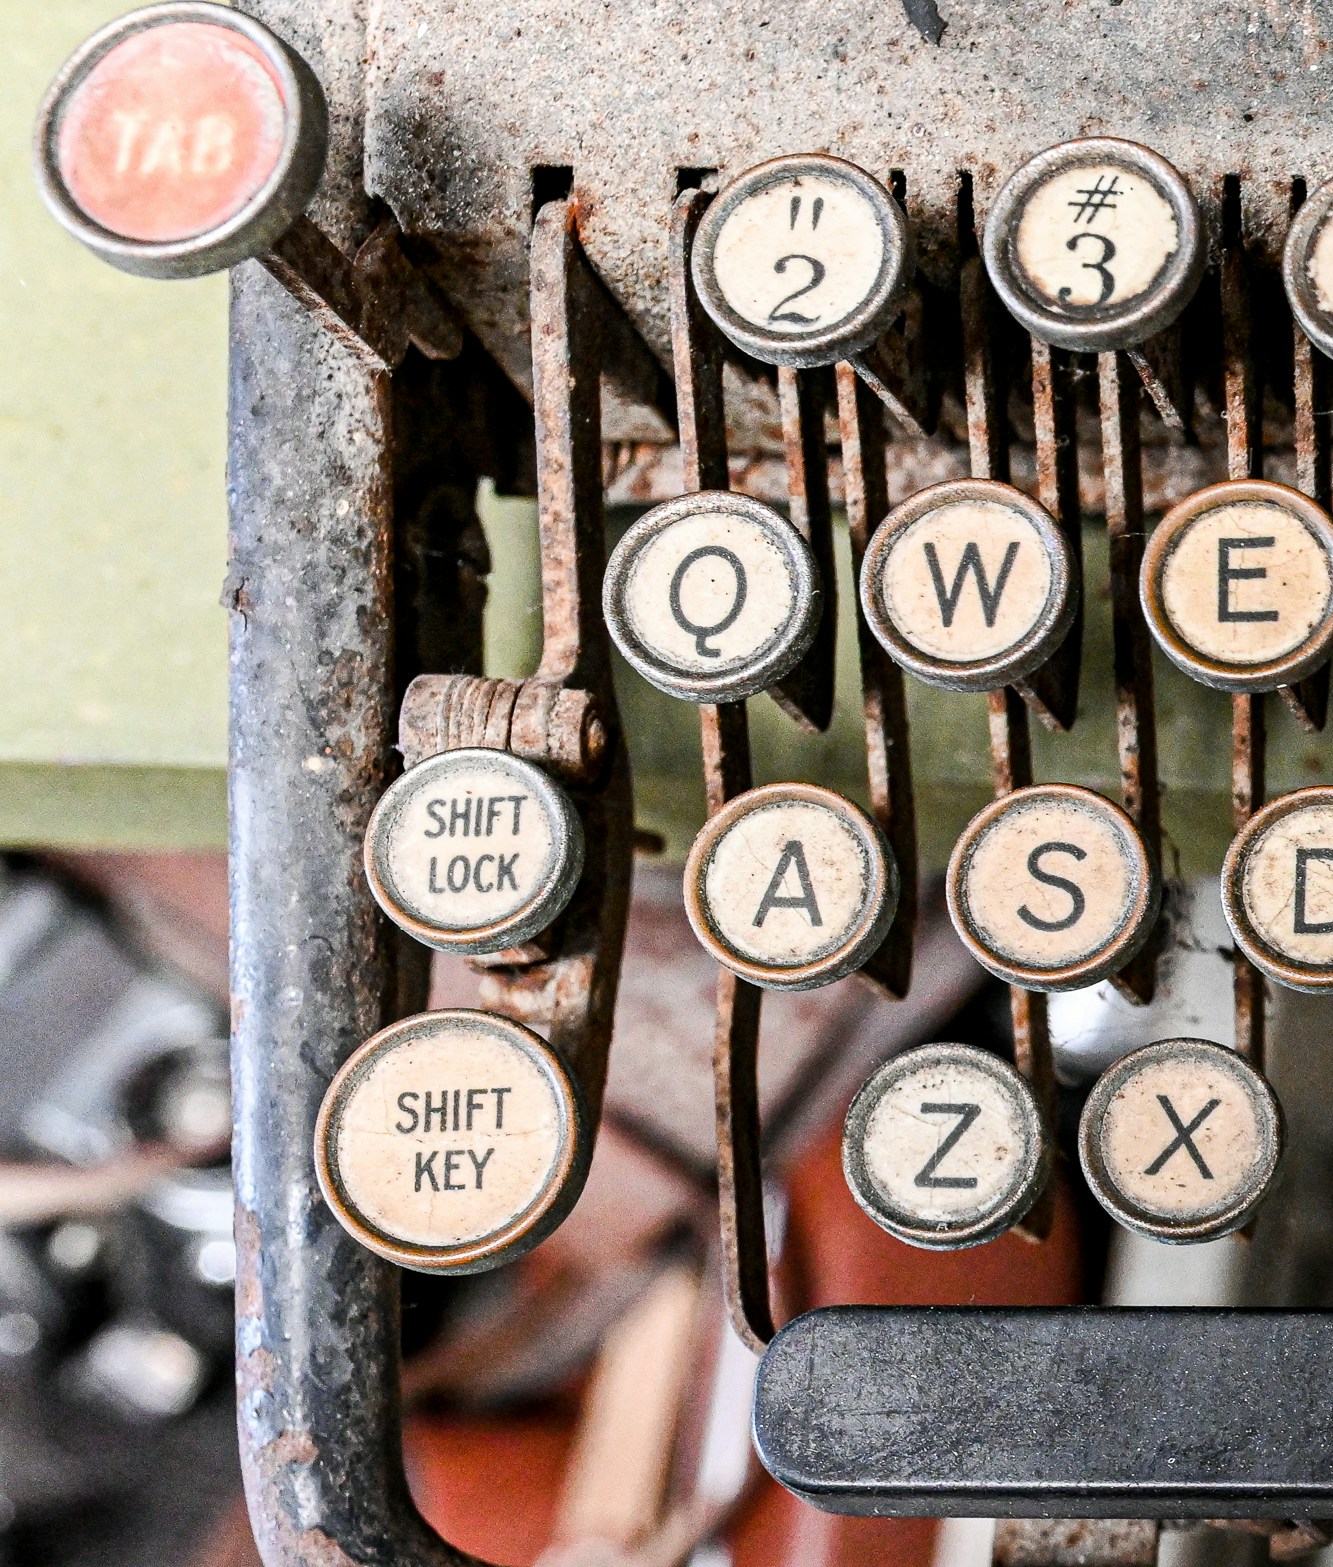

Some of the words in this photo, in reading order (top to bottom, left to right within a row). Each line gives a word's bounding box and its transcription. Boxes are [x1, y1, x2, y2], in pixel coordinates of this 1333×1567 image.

[113, 109, 236, 175] TAB
[1067, 175, 1120, 225] #
[768, 254, 827, 325] 2
[1064, 233, 1117, 307] 3
[668, 545, 747, 659] Q
[923, 541, 1021, 628] W
[1217, 536, 1280, 624] E
[423, 796, 527, 840] SHIFT
[428, 853, 520, 893] LOCK
[751, 839, 824, 929] A
[1016, 841, 1088, 933] S
[396, 1087, 512, 1136] SHIFT
[913, 1102, 982, 1190] Z
[1143, 1094, 1222, 1180] X
[413, 1148, 495, 1193] KEY
